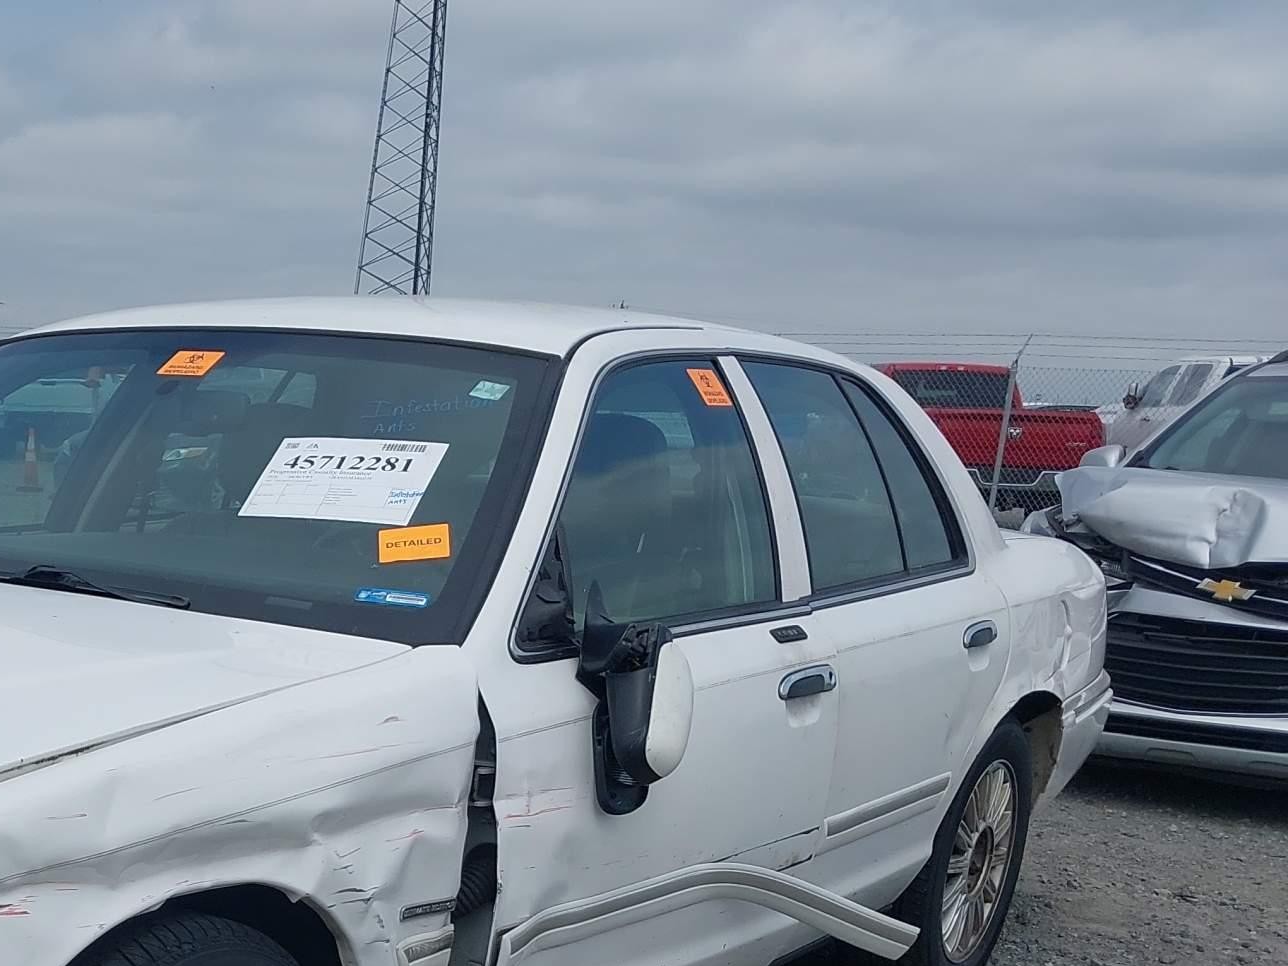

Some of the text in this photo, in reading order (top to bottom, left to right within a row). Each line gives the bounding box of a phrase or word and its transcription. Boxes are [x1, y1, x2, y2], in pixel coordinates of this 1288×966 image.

[360, 394, 494, 418] Infestation
[283, 454, 414, 473] 45712281
[385, 537, 442, 549] DETAILED
